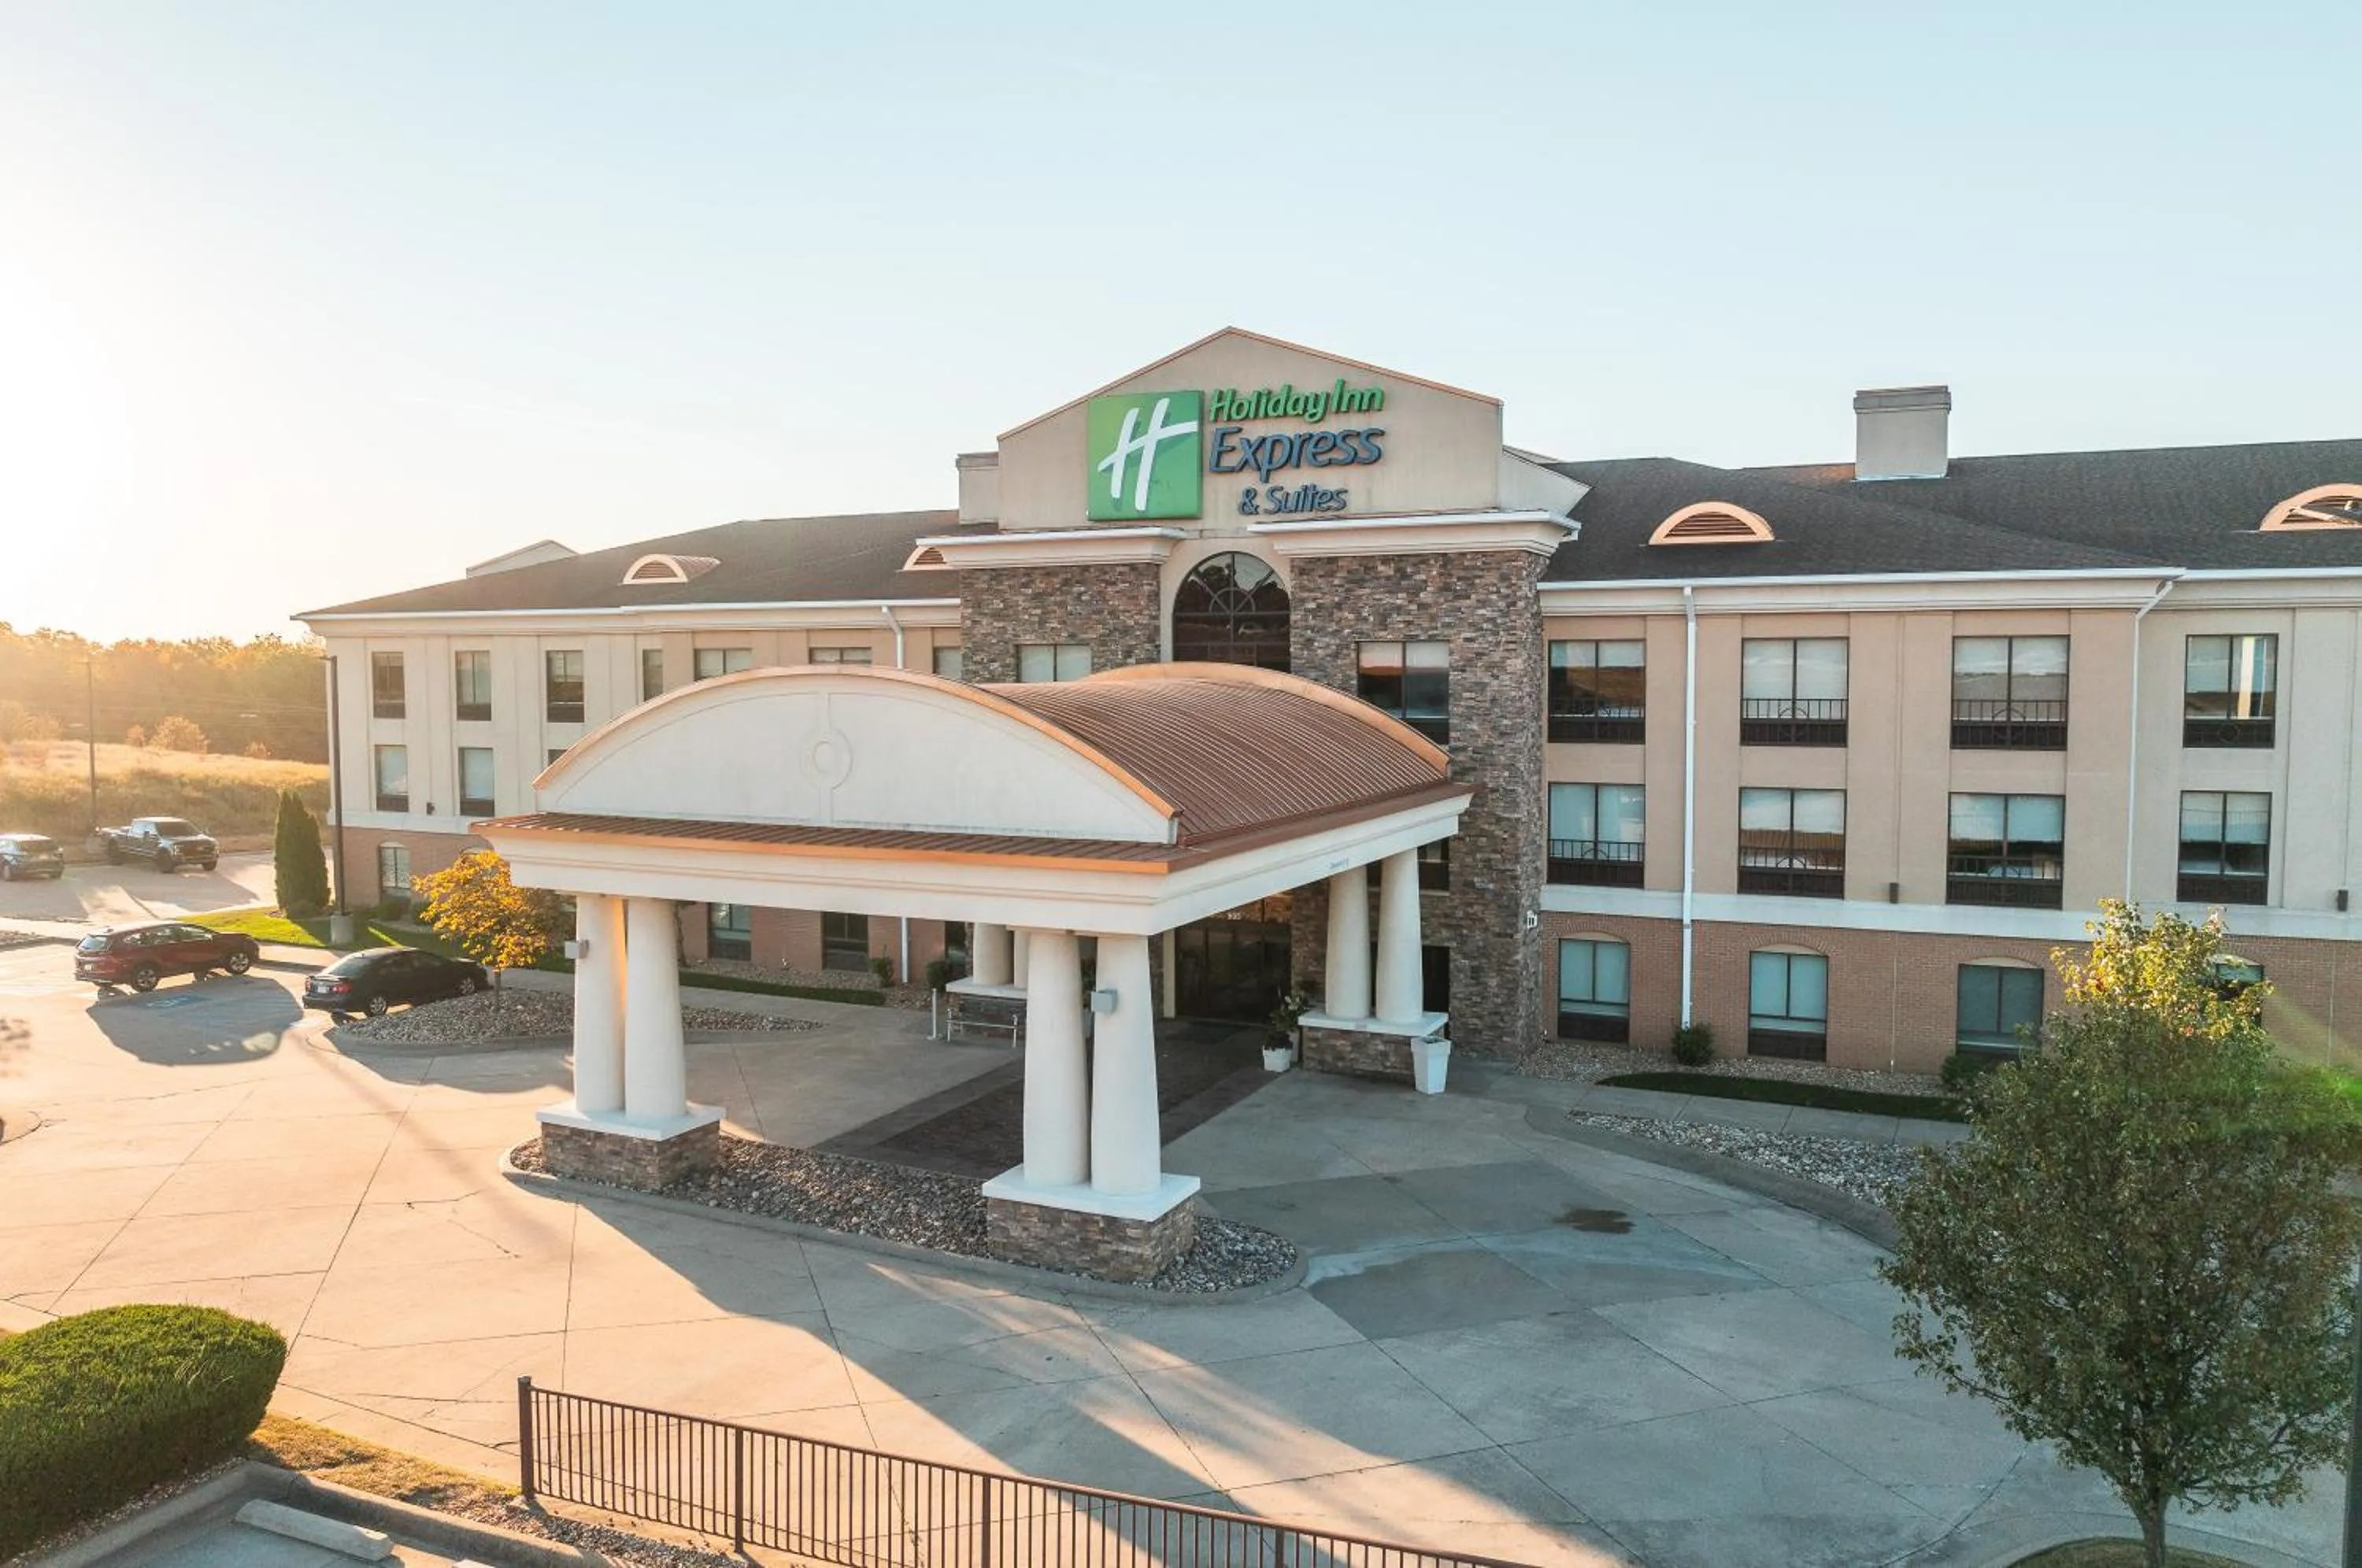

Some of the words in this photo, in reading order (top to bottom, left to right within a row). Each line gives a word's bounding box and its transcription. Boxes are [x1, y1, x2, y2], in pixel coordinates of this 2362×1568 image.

[1209, 385, 1326, 423] Holiday
[1331, 378, 1385, 413] Inn
[1098, 398, 1198, 512] H
[1209, 426, 1385, 483] Express
[1238, 488, 1260, 515] &
[1263, 483, 1348, 514] Suites
